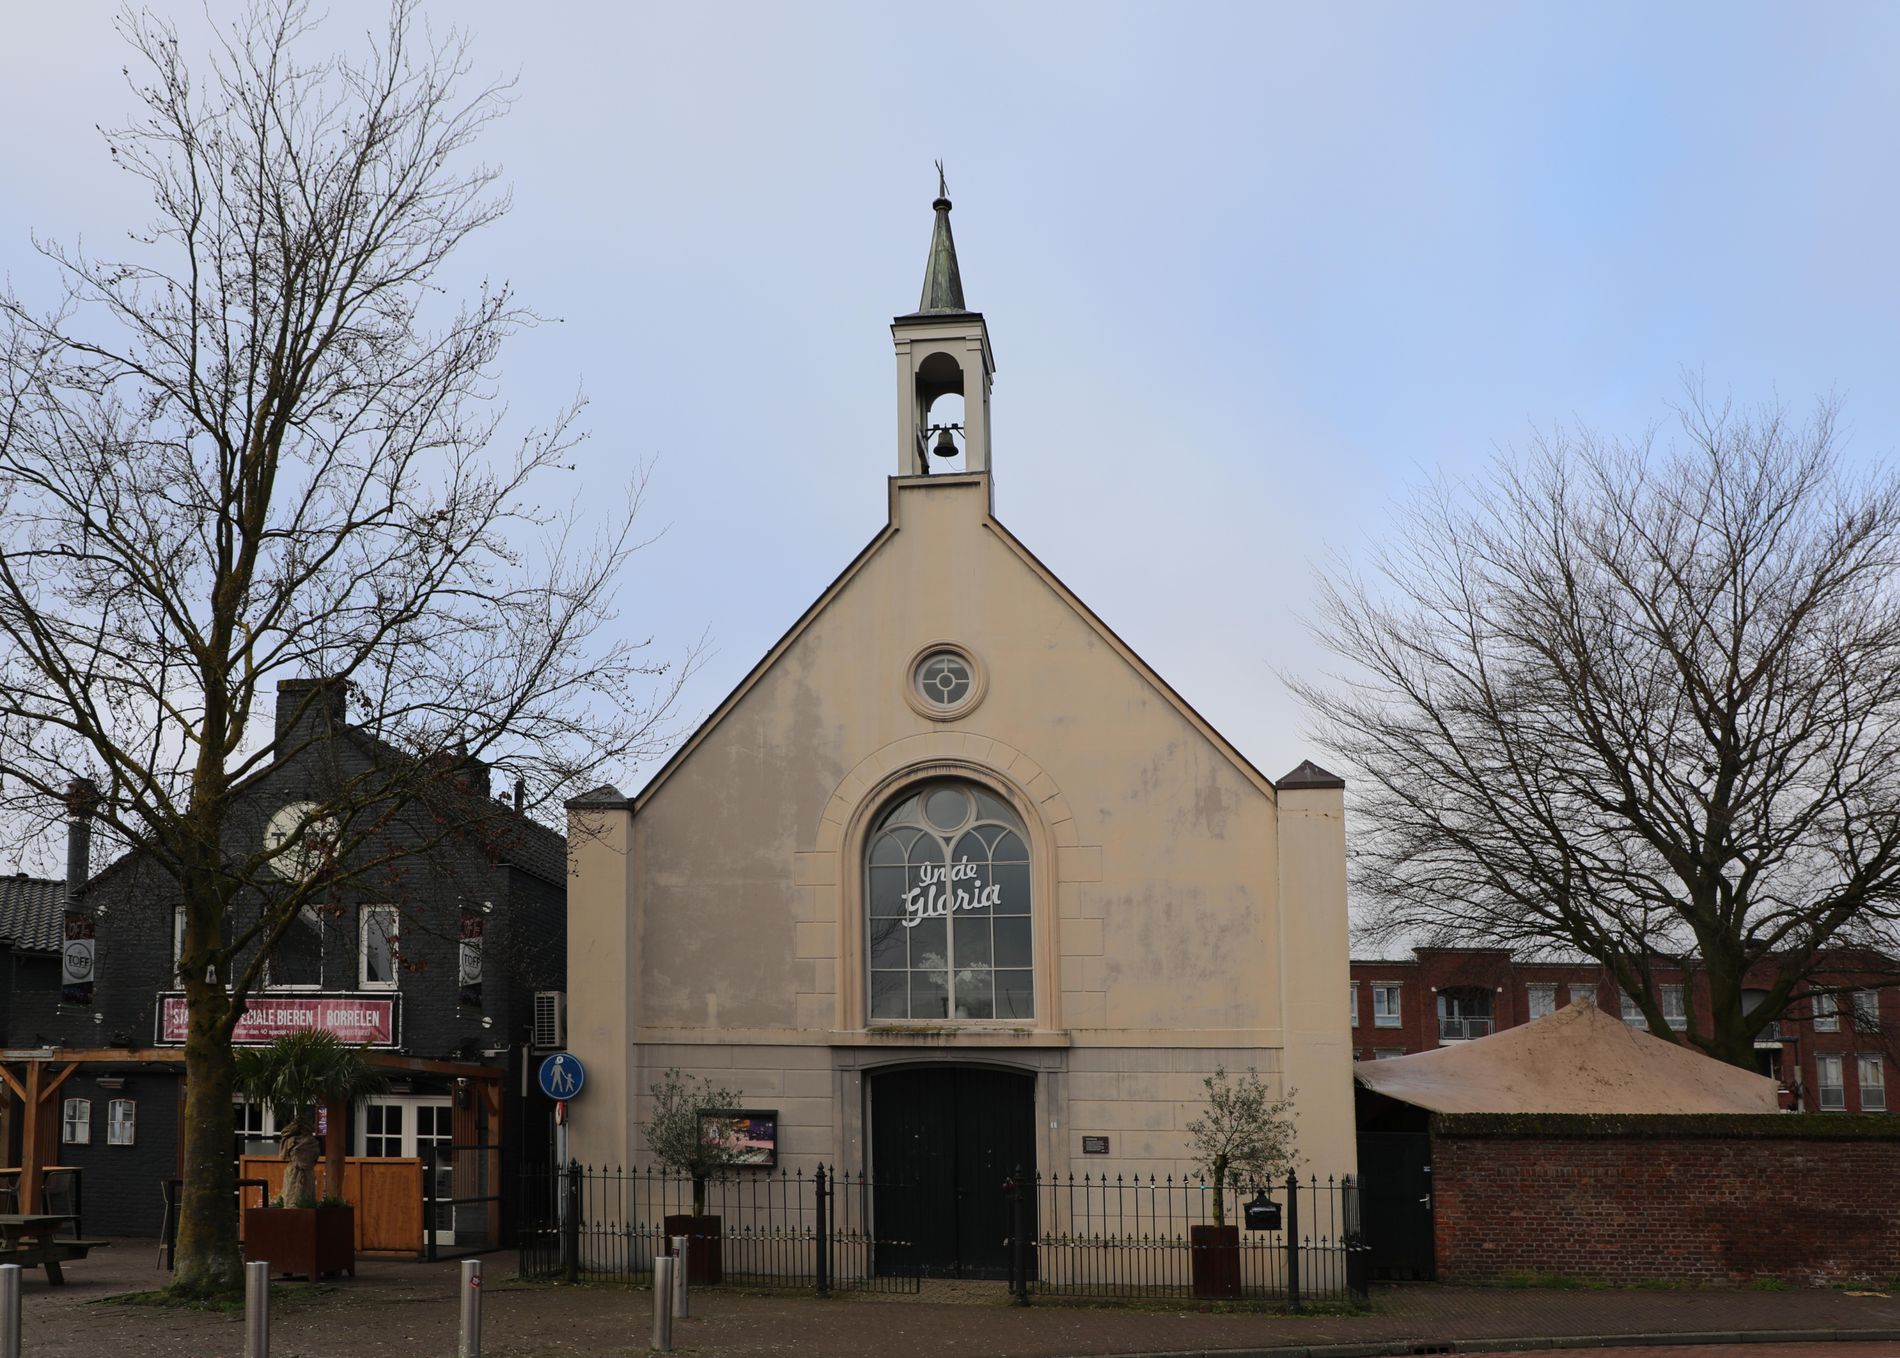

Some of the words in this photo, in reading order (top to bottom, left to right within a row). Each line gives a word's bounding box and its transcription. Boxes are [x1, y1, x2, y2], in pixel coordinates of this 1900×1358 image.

[919, 861, 947, 887] In
[951, 855, 977, 881] de
[901, 880, 1002, 928] Gloria
[67, 954, 90, 967] TOFF
[276, 1010, 313, 1026] BIEREN
[326, 1010, 380, 1027] BORRELEN
